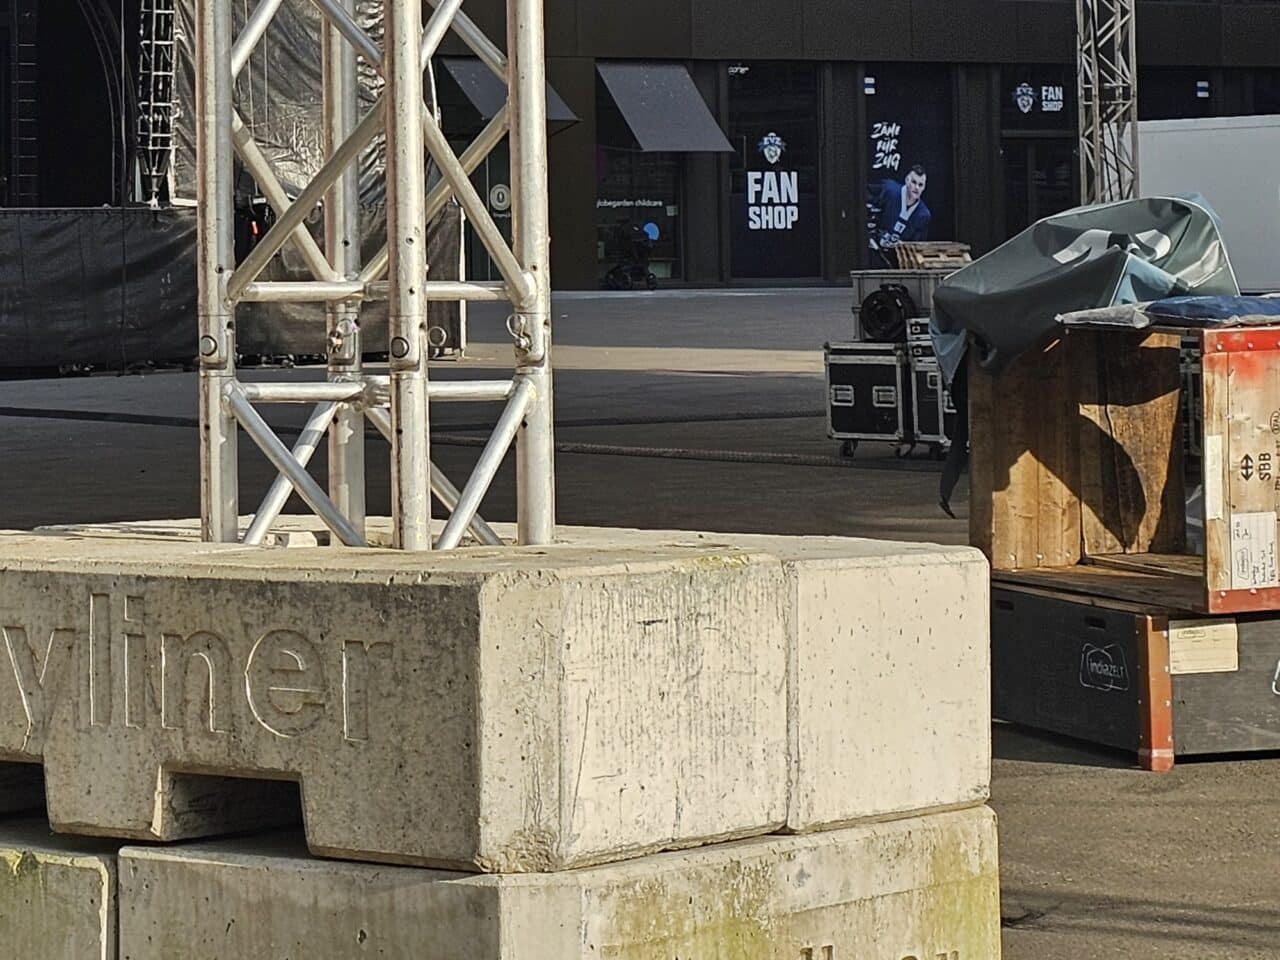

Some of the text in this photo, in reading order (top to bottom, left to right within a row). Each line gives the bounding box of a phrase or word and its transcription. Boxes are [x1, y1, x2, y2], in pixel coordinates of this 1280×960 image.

[1041, 86, 1063, 100] FAN
[1041, 101, 1063, 111] SHOP
[747, 171, 798, 204] FAN
[748, 205, 799, 230] SHOP
[1258, 452, 1272, 481] SBB
